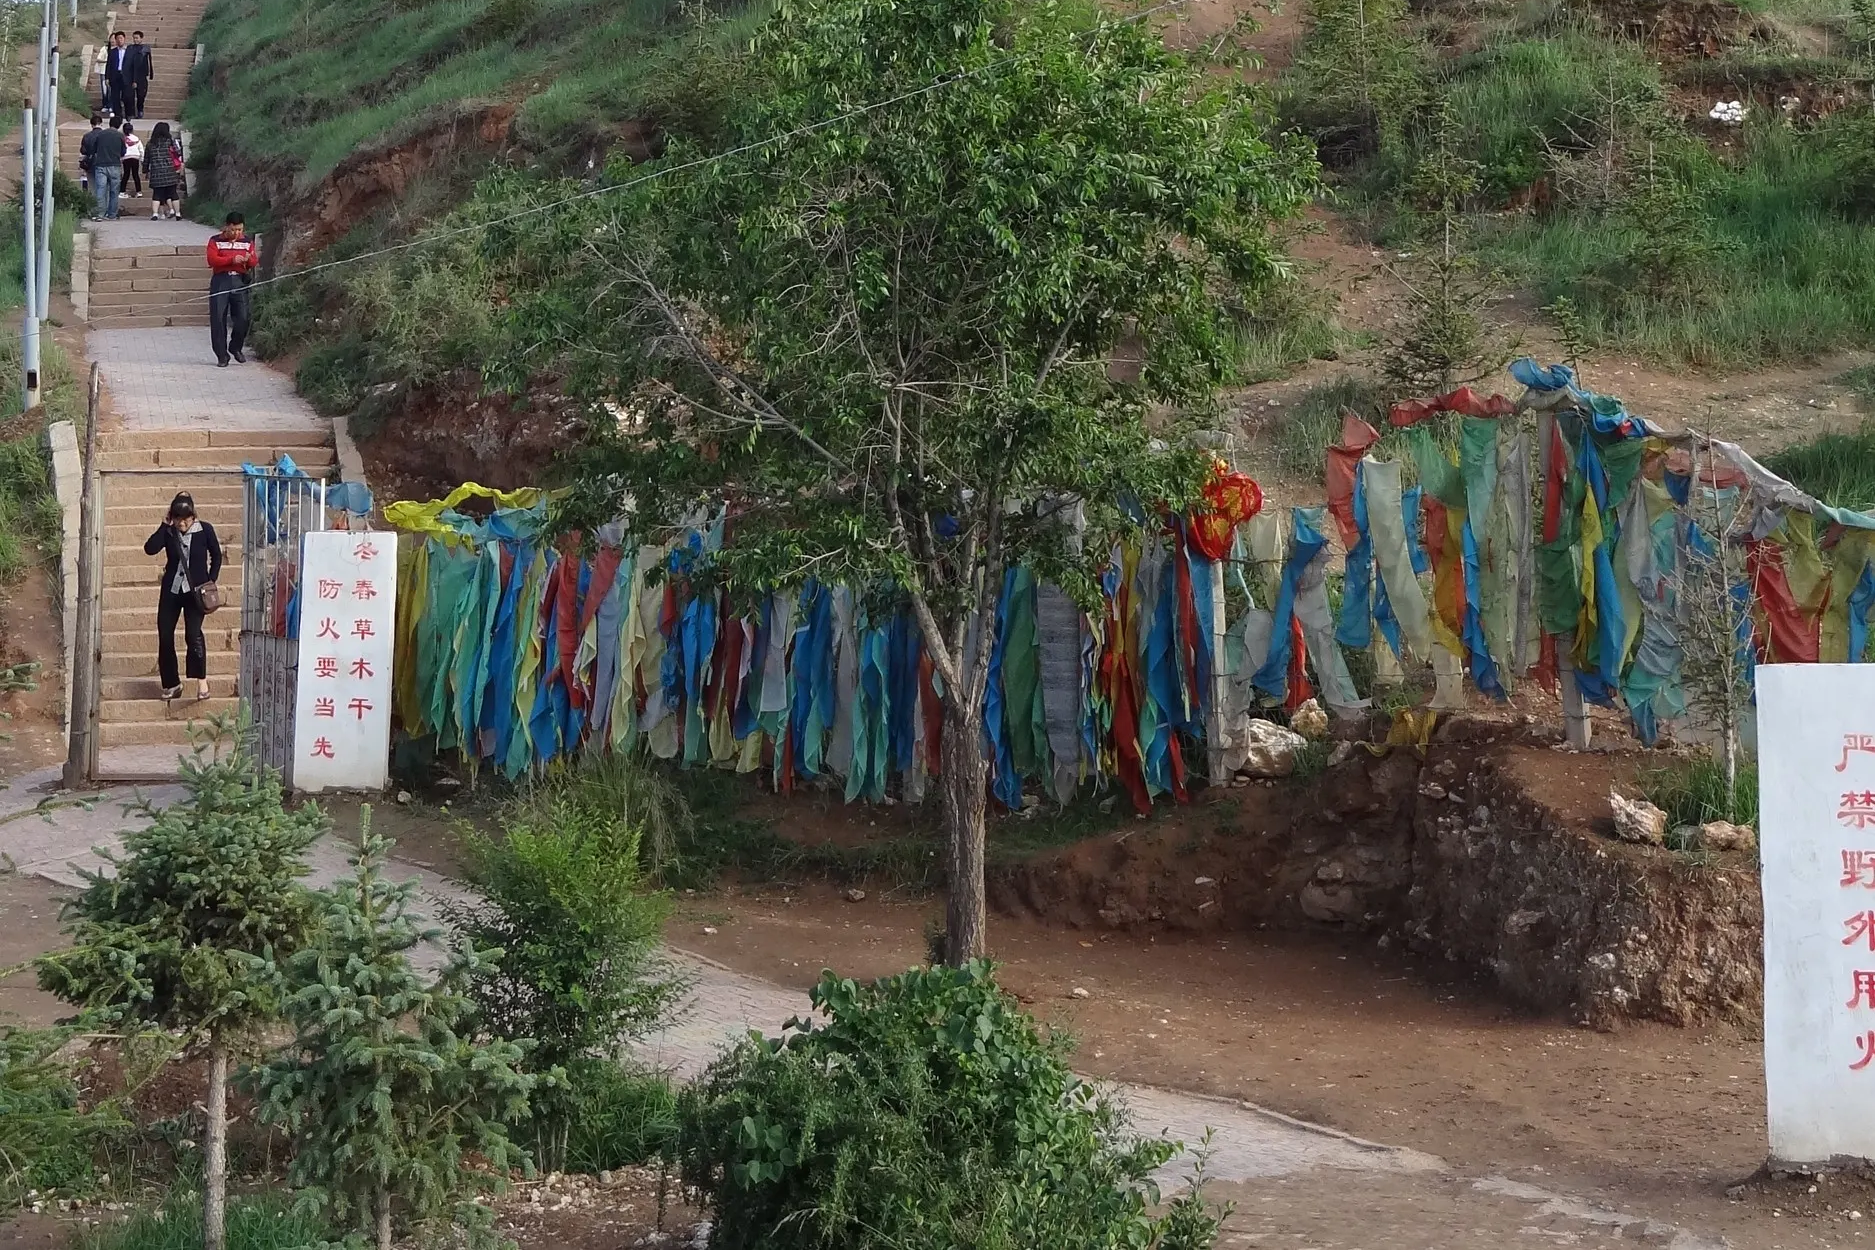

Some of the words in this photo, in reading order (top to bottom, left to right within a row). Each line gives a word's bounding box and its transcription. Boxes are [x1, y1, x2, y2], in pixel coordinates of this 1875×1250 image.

[310, 578, 343, 759] 防火要当先
[348, 541, 379, 720] 冬春草木干
